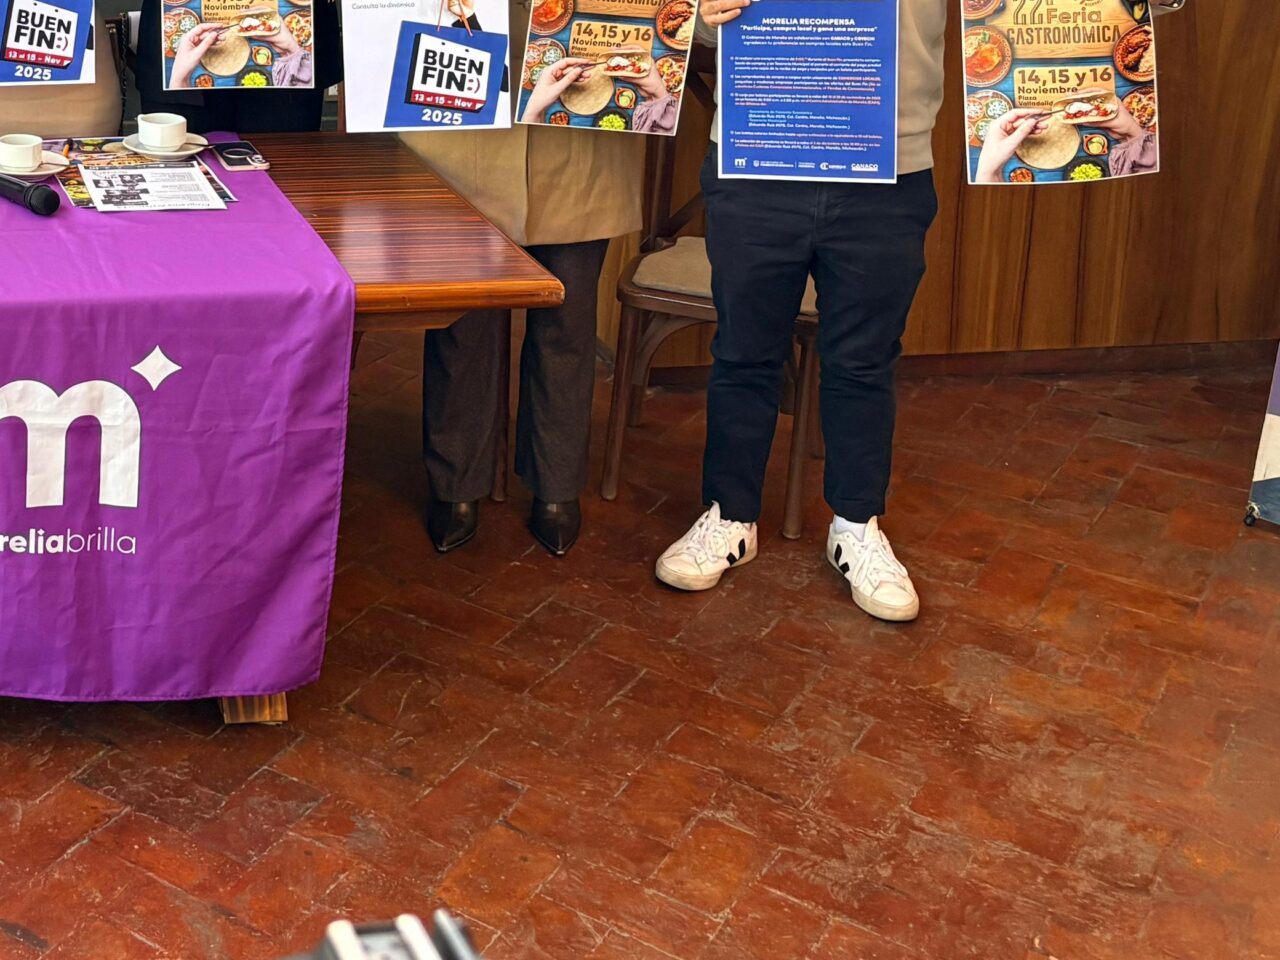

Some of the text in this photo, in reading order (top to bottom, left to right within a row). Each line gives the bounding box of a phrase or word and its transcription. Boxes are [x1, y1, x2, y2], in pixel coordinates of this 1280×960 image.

[204, 3, 250, 11] Noviembre
[1046, 6, 1101, 23] Feria
[17, 8, 71, 34] BUEN
[621, 30, 631, 43] y
[634, 28, 651, 42] 16
[1007, 24, 1119, 45] GASTRONÓMICA
[572, 37, 622, 48] Noviembre
[45, 55, 61, 64] Nov
[423, 48, 484, 76] BUEN
[15, 65, 51, 80] 2025
[1075, 71, 1086, 85] y
[1089, 67, 1111, 81] 16
[1018, 84, 1078, 94] Noviembre
[455, 98, 472, 108] Nov
[422, 108, 462, 124] 2025
